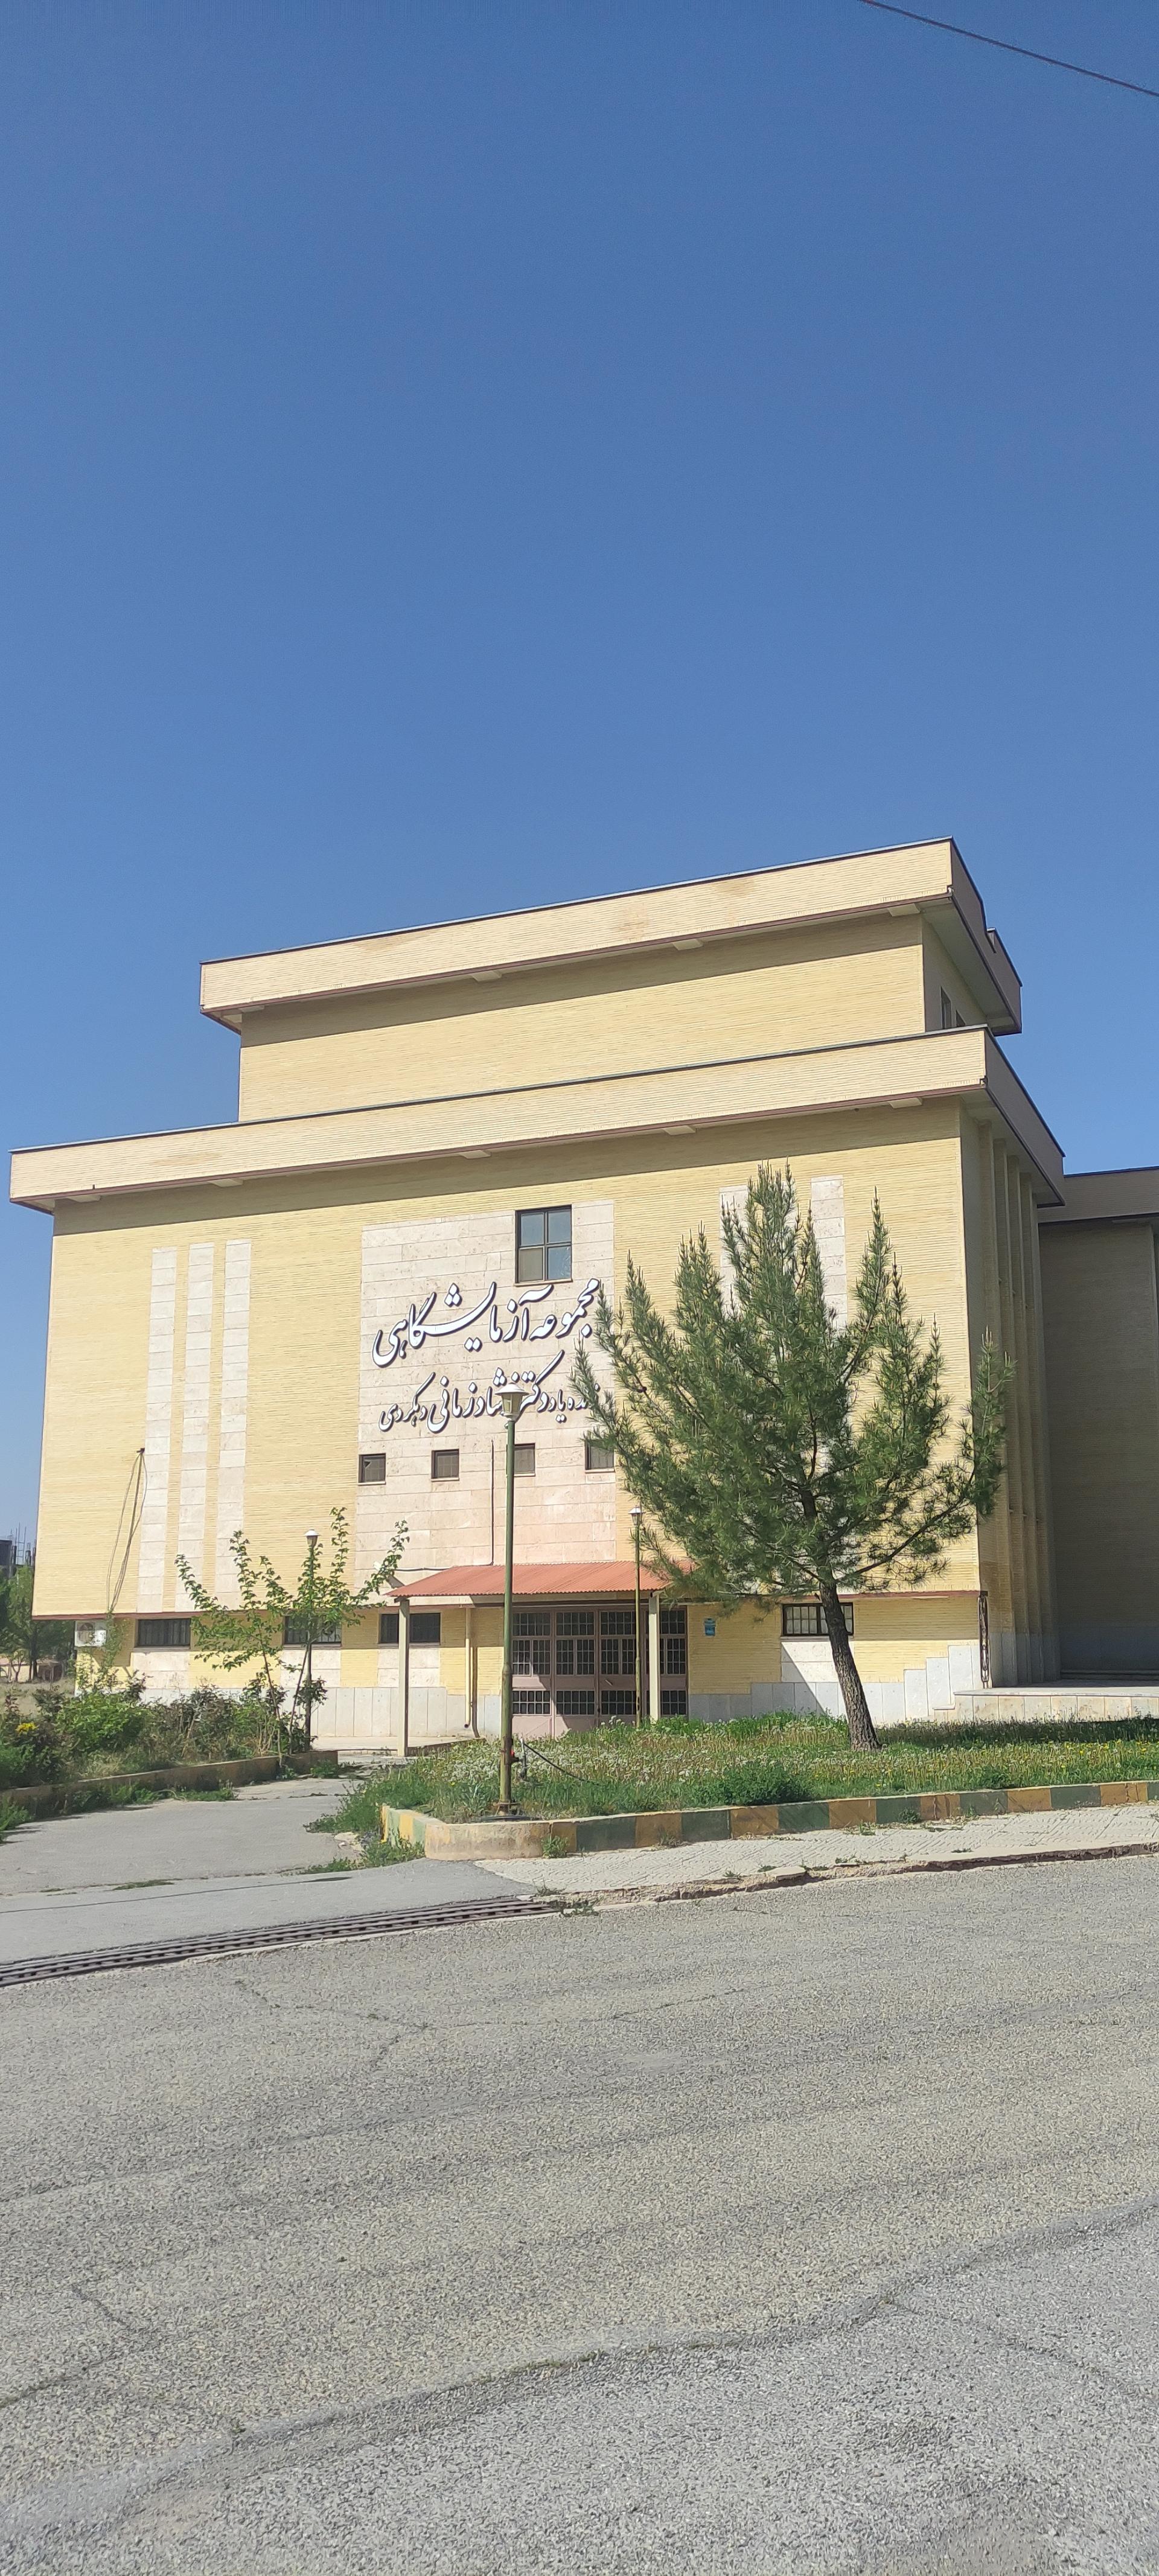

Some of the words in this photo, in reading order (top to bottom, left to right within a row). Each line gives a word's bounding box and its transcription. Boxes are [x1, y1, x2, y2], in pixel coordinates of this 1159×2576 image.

[372, 1281, 554, 1368] آزمایشگاهی
[529, 1278, 600, 1341] مجموعه
[378, 1371, 436, 1432] دهکردی
[427, 1376, 478, 1434] زمانی
